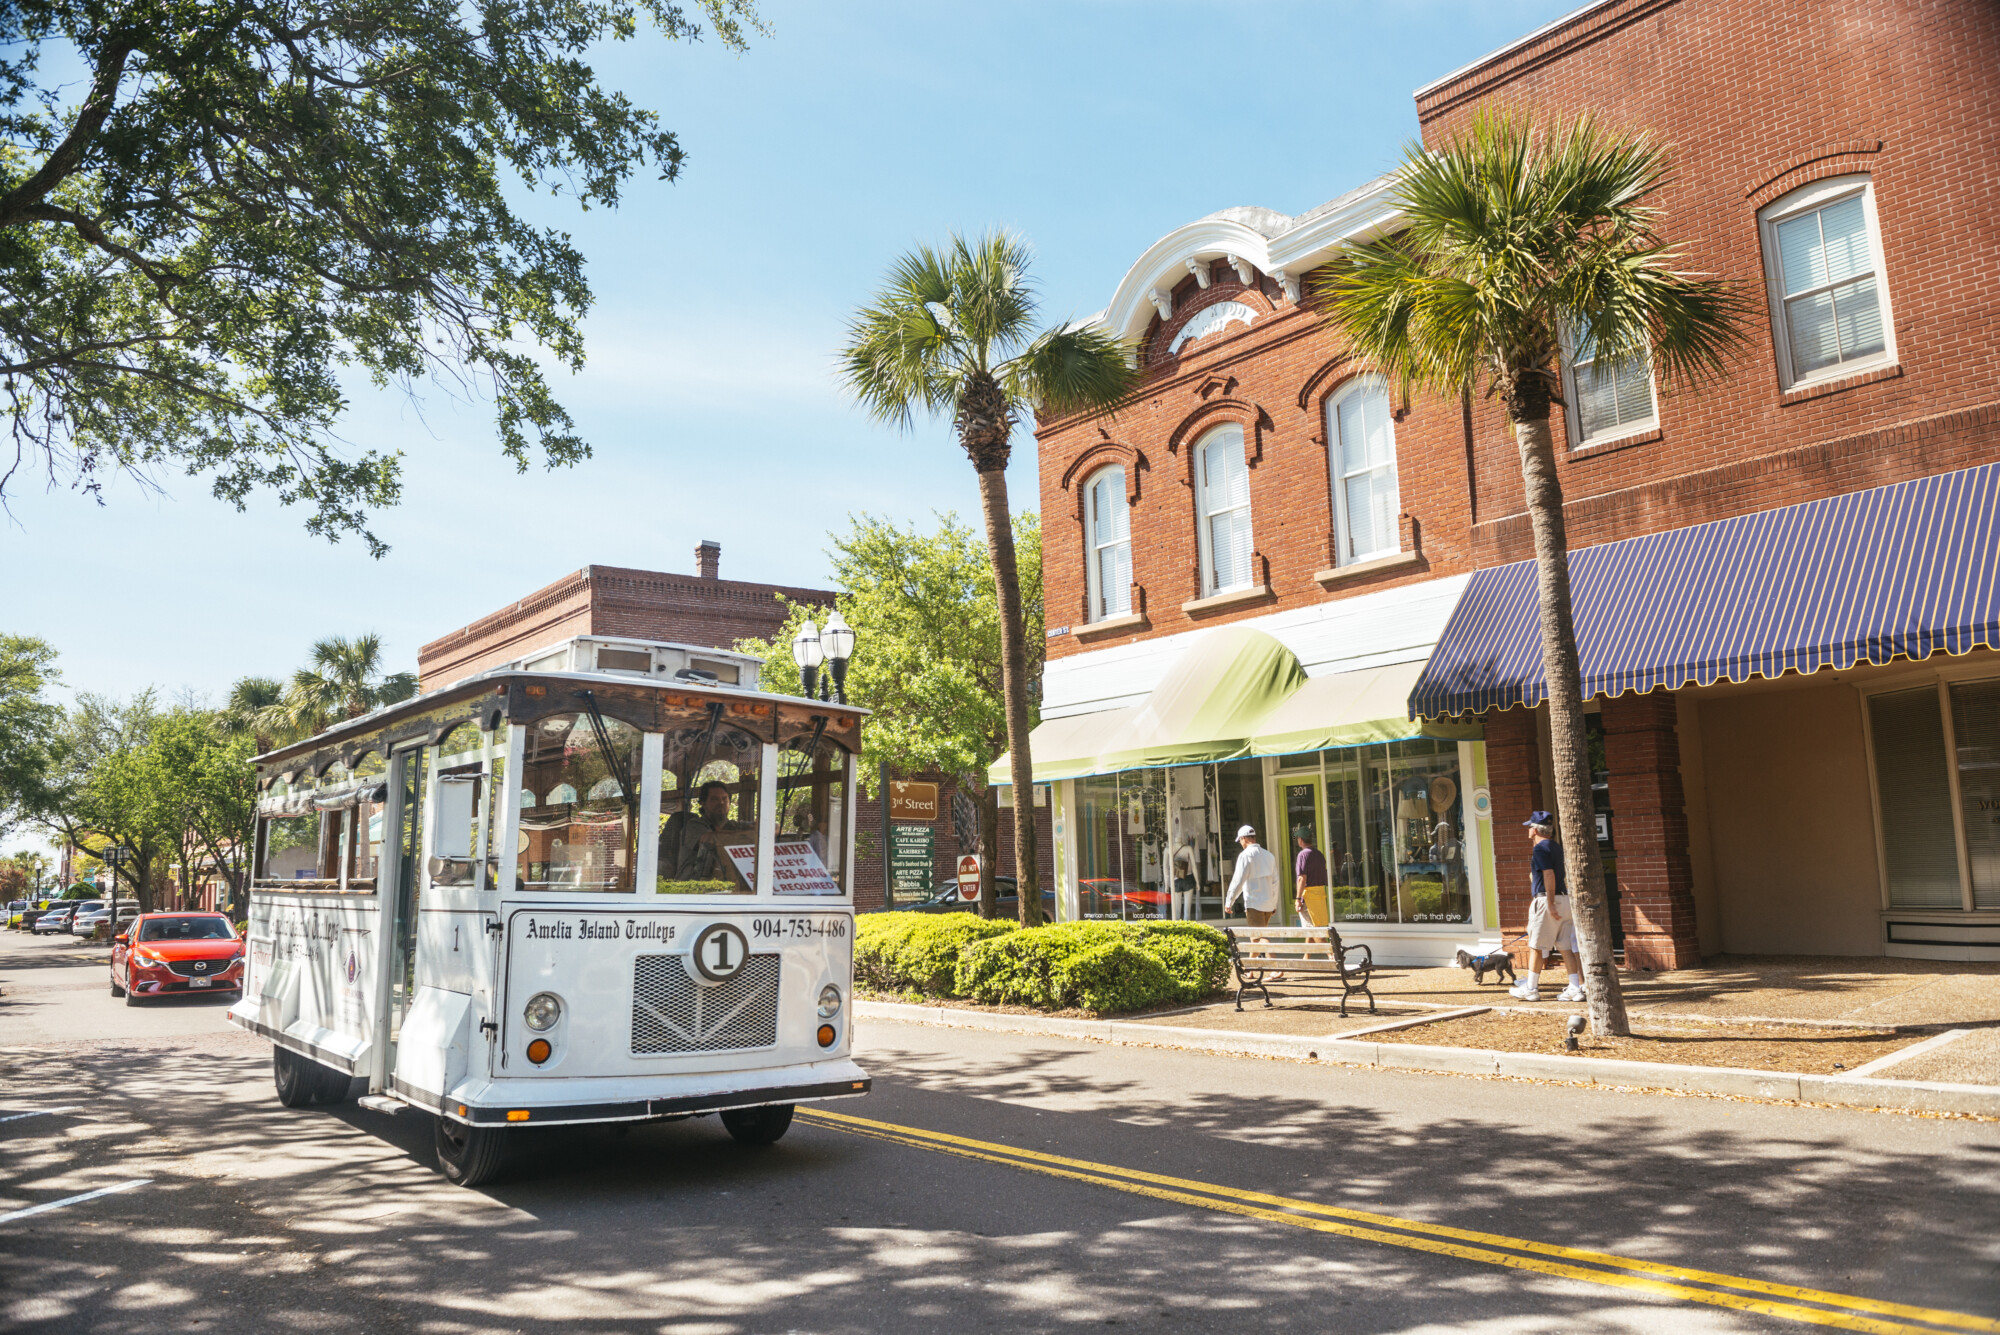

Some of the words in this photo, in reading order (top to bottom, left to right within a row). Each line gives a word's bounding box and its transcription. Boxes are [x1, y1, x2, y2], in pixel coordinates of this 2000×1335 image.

[1293, 786, 1307, 797] 301
[892, 797, 903, 808] 3rd
[905, 799, 934, 810] Street
[774, 843, 812, 856] ANTED
[968, 864, 977, 872] NOT
[781, 882, 834, 891] REQUIRED
[962, 884, 976, 892] ENTER
[1345, 912, 1388, 921] earth-friendly
[1413, 912, 1428, 921] gifts
[1429, 912, 1444, 920] that
[1445, 913, 1461, 922] give
[526, 918, 572, 939] Amelia
[578, 919, 620, 940] Island
[625, 919, 675, 944] Trolleys
[752, 918, 846, 938] 904-753-4486
[710, 932, 734, 970] 1
